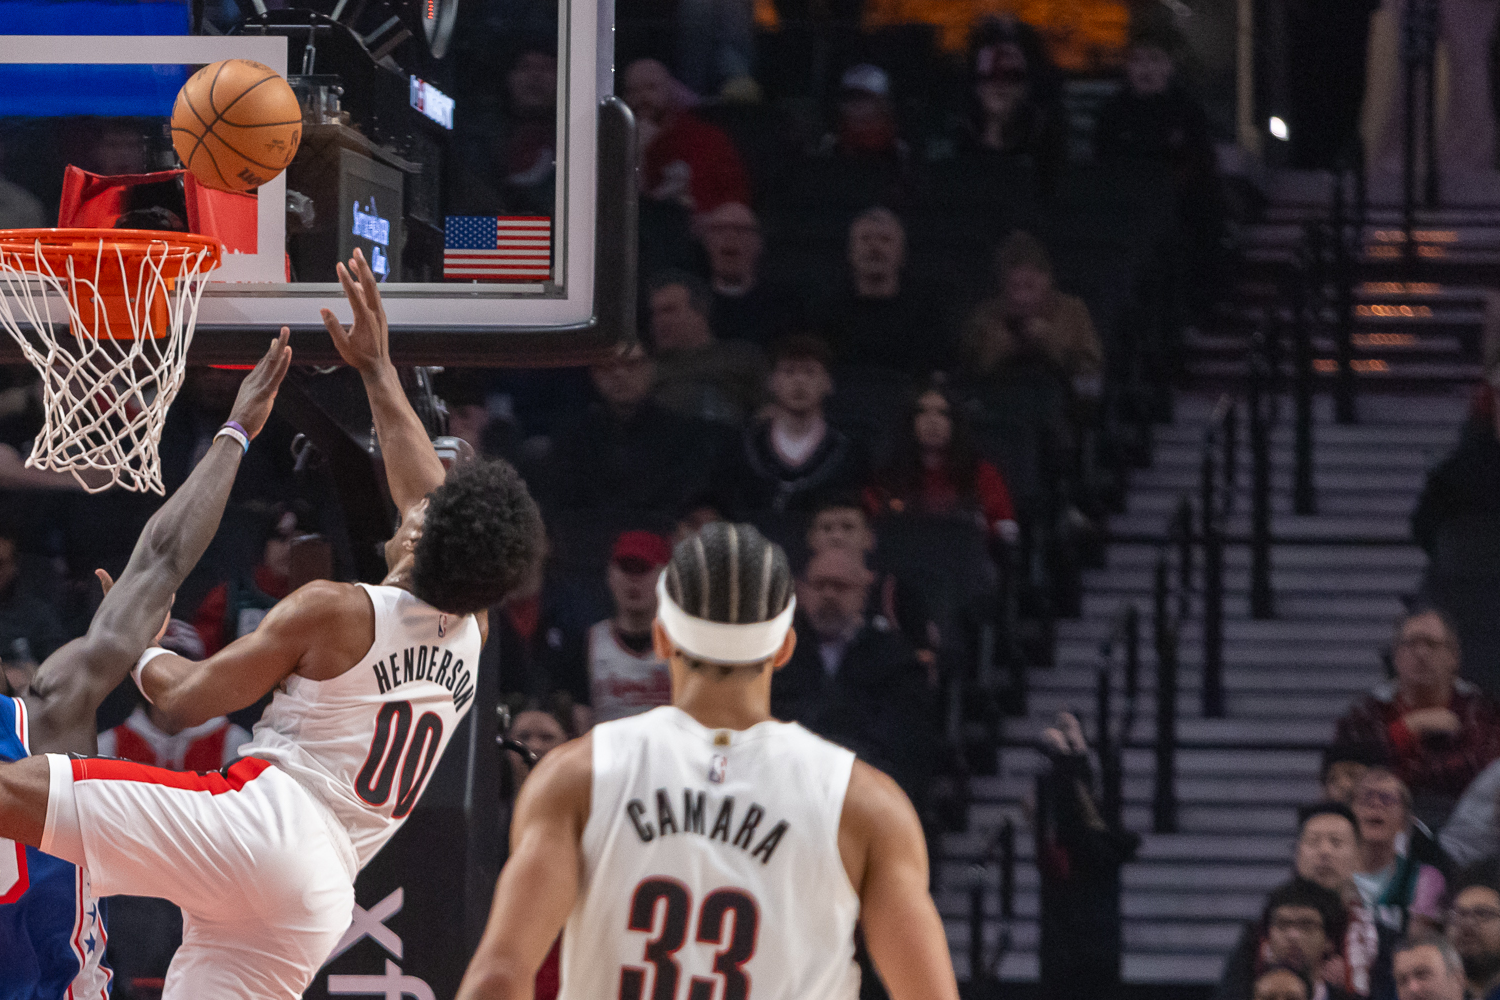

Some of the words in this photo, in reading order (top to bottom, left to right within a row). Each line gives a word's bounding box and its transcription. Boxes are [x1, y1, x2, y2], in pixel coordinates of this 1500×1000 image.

[372, 645, 475, 713] HENDERSON
[354, 700, 444, 819] 00
[626, 787, 791, 866] CAMARA
